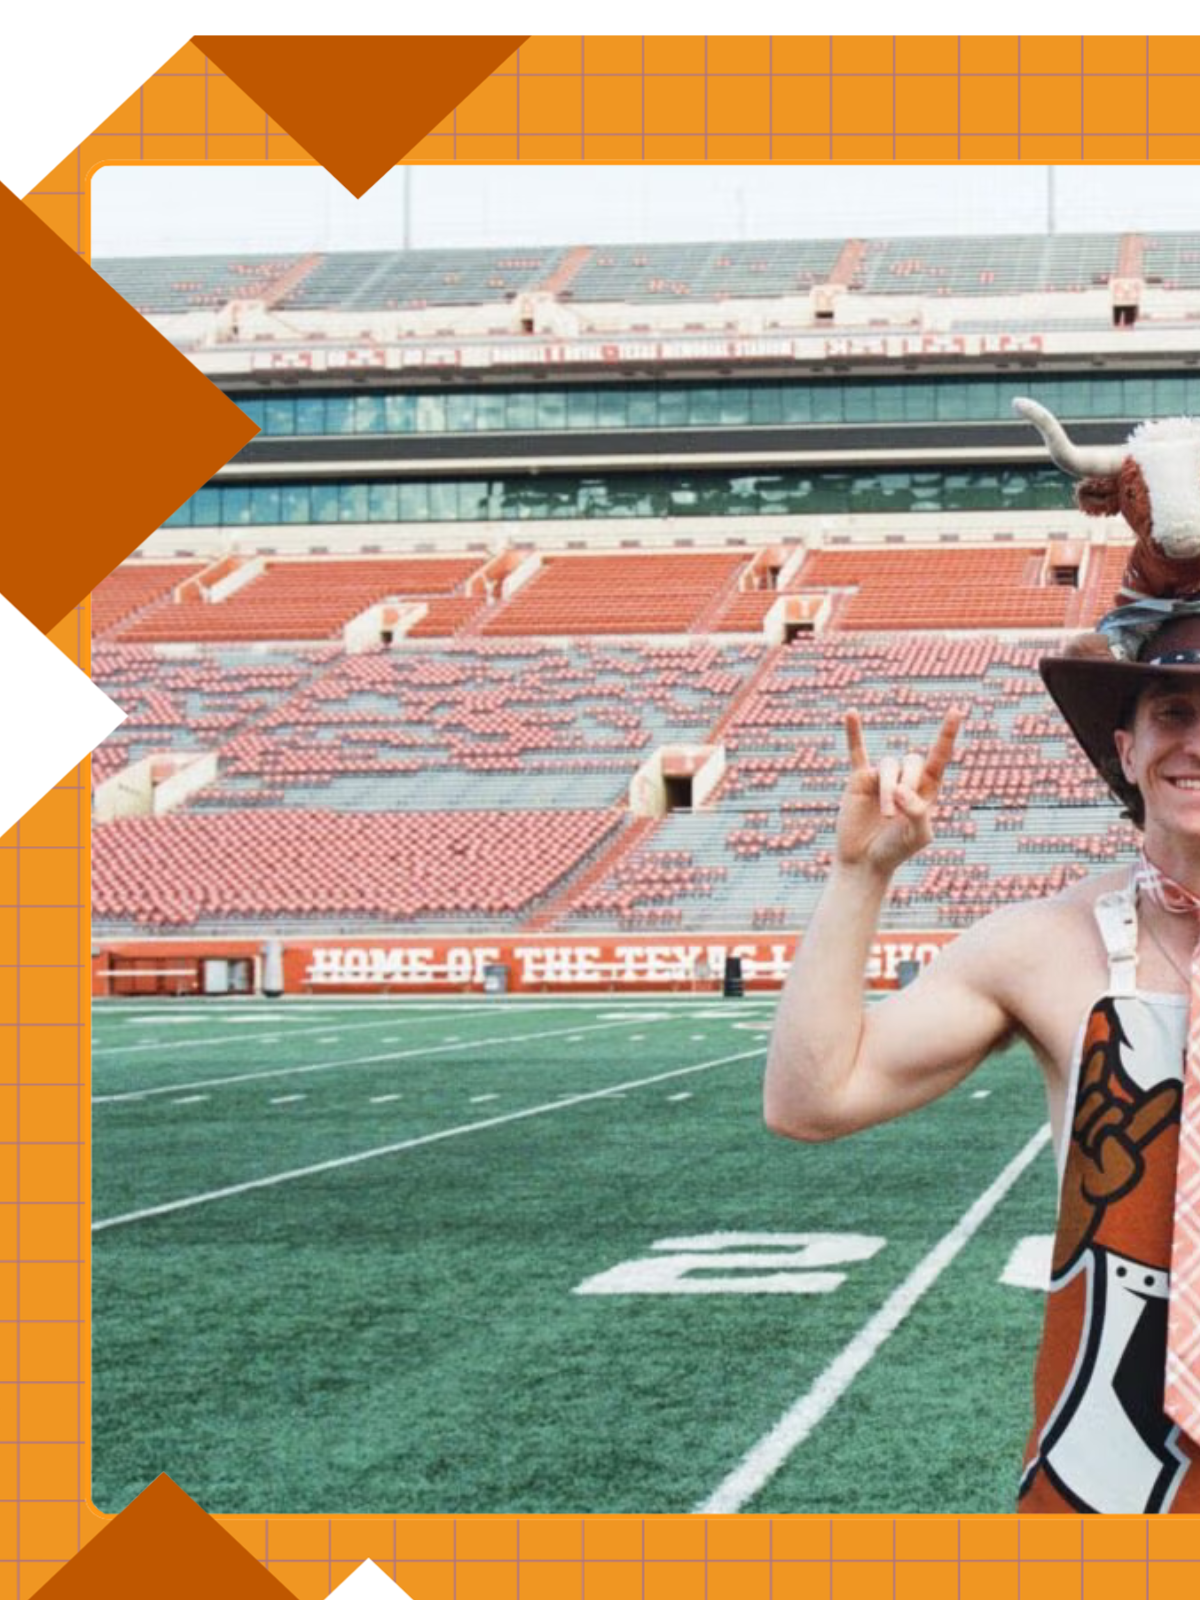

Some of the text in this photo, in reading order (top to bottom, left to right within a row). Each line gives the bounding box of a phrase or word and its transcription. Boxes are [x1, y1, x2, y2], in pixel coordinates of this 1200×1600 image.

[312, 946, 434, 983] HOME
[447, 946, 500, 983] OF
[513, 946, 600, 983] THE
